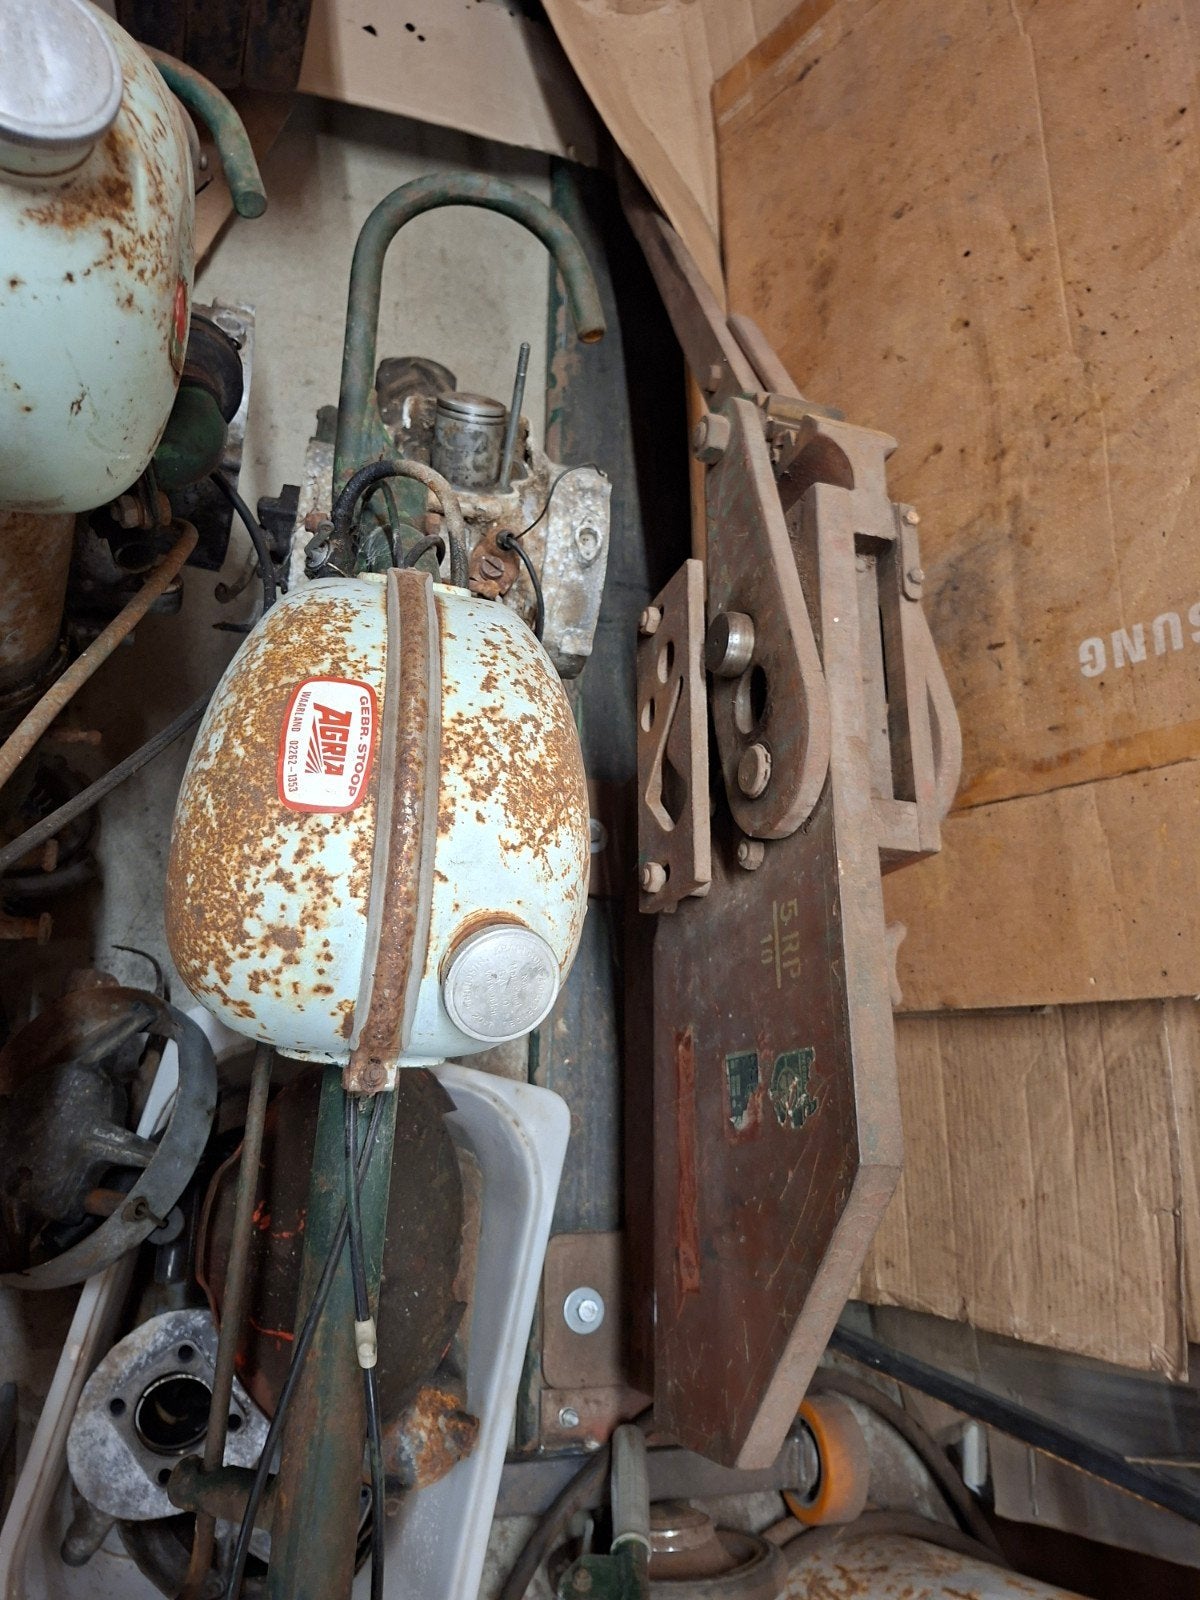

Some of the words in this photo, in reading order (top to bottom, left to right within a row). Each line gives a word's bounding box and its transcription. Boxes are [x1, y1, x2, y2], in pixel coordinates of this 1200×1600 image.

[291, 691, 311, 732] WAARLAND
[360, 696, 369, 740] GEBR.
[313, 703, 353, 776] AGRIA
[348, 744, 368, 797] STOOP
